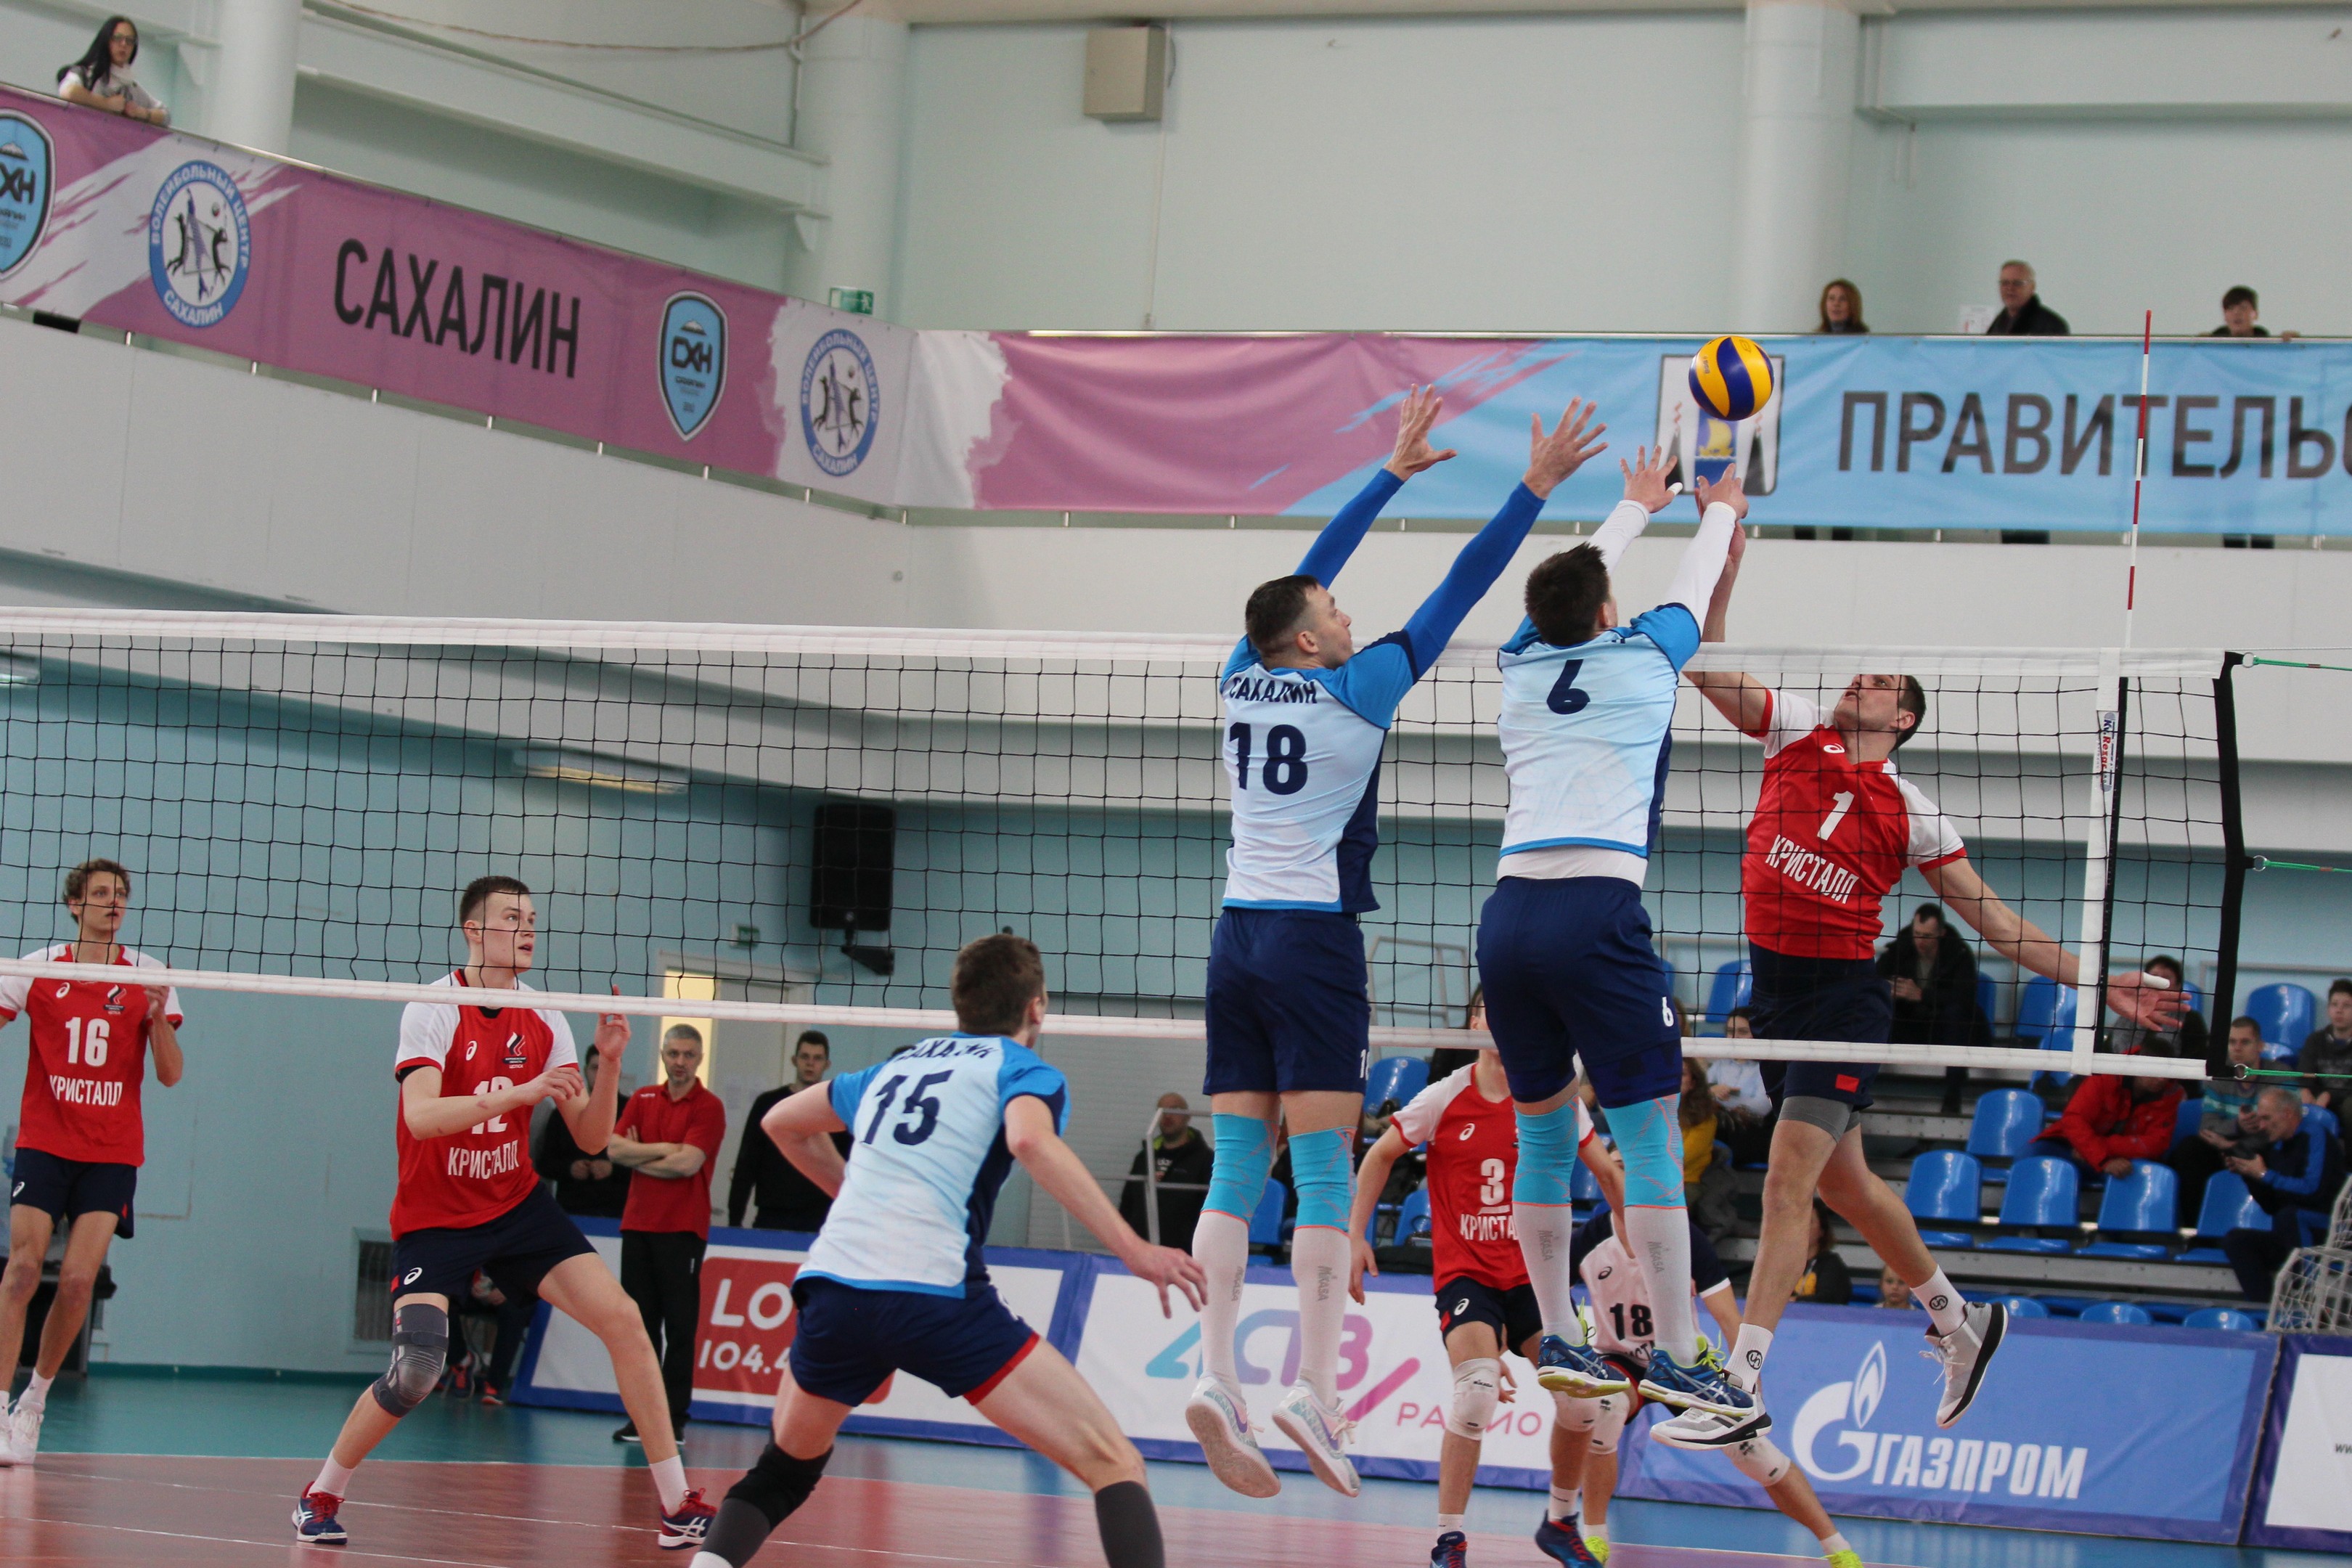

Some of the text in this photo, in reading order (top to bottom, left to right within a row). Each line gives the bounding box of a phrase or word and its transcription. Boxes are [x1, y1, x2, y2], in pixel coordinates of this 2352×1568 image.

[335, 238, 580, 379] САХАЛИН
[1837, 391, 2352, 480] ПРАВИТЕЛЬ
[1546, 658, 1591, 715] 6
[1229, 721, 1309, 796] 18
[1816, 790, 1855, 841] 1
[1765, 834, 1860, 905] КРИСТАЛЛ
[1662, 996, 1675, 1027] 6
[65, 1016, 110, 1068] 16
[49, 1074, 123, 1106] КРИСТАЛЛ
[860, 1069, 955, 1146] 15
[1480, 1157, 1506, 1206] 3
[1460, 1213, 1519, 1241] КРИСТА
[710, 1278, 794, 1330] LO
[1609, 1302, 1654, 1342] 18
[1397, 1402, 1543, 1437] РАИО
[1871, 1432, 2088, 1500] ГАЗПРОМ
